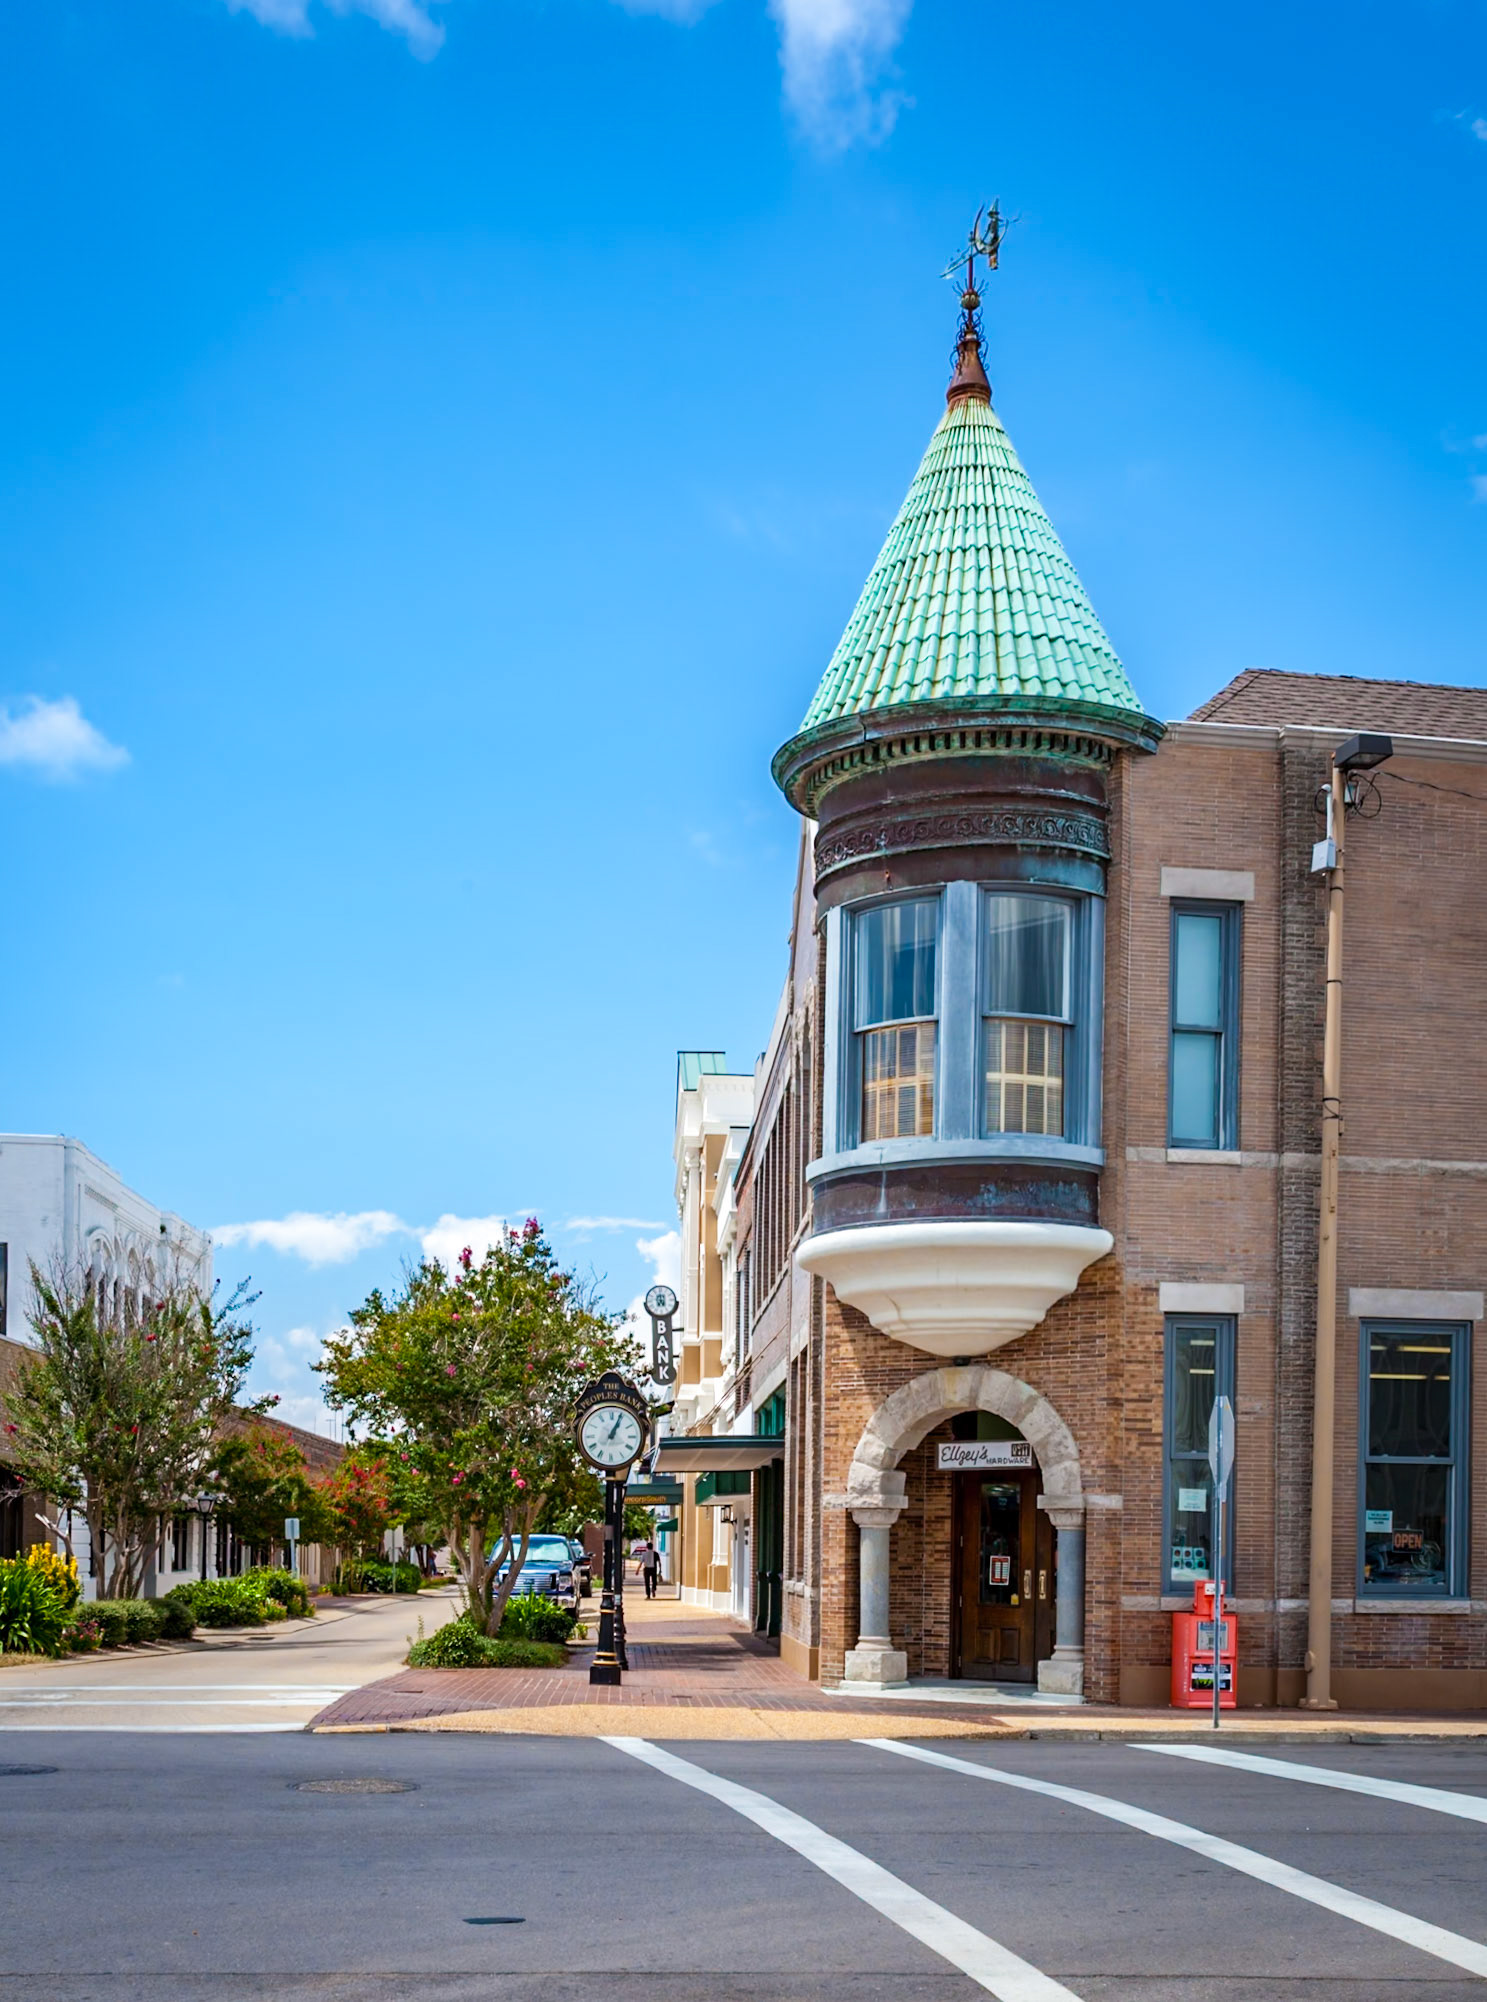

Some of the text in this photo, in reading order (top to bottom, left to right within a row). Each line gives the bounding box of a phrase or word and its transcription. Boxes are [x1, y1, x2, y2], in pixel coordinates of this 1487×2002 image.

[656, 1319, 670, 1380] BANK
[602, 1382, 620, 1390] THE
[580, 1391, 644, 1410] PEOPLES BANK
[940, 1445, 989, 1466] Ellzey's
[986, 1456, 1030, 1465] HARDWARE
[623, 1495, 667, 1505] ncorpSouth
[1394, 1533, 1423, 1549] OPEN
